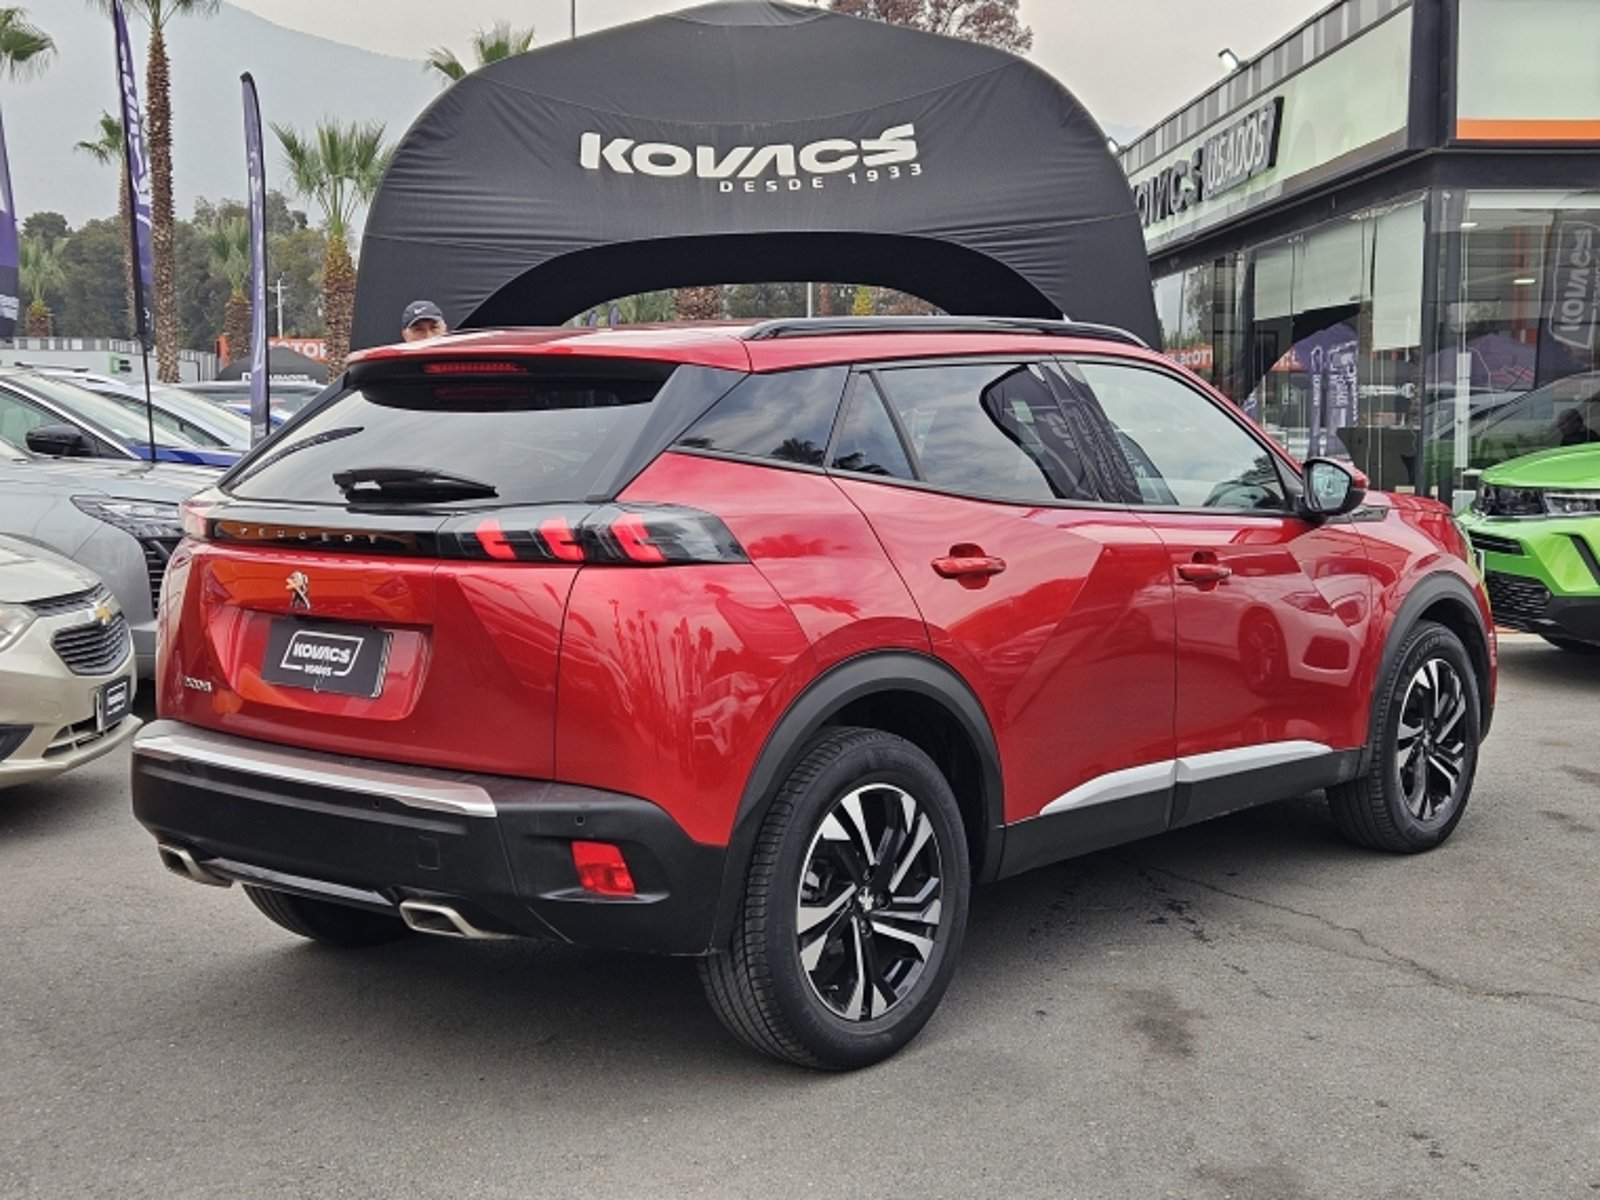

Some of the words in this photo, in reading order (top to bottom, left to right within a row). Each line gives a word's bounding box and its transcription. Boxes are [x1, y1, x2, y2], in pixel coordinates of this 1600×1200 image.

[580, 123, 918, 178] KOVACS
[719, 175, 824, 193] DESDE
[848, 163, 921, 185] 1933
[1134, 147, 1203, 228] OVACS
[240, 527, 377, 544] PEUGEOT
[292, 642, 351, 664] KOVACS
